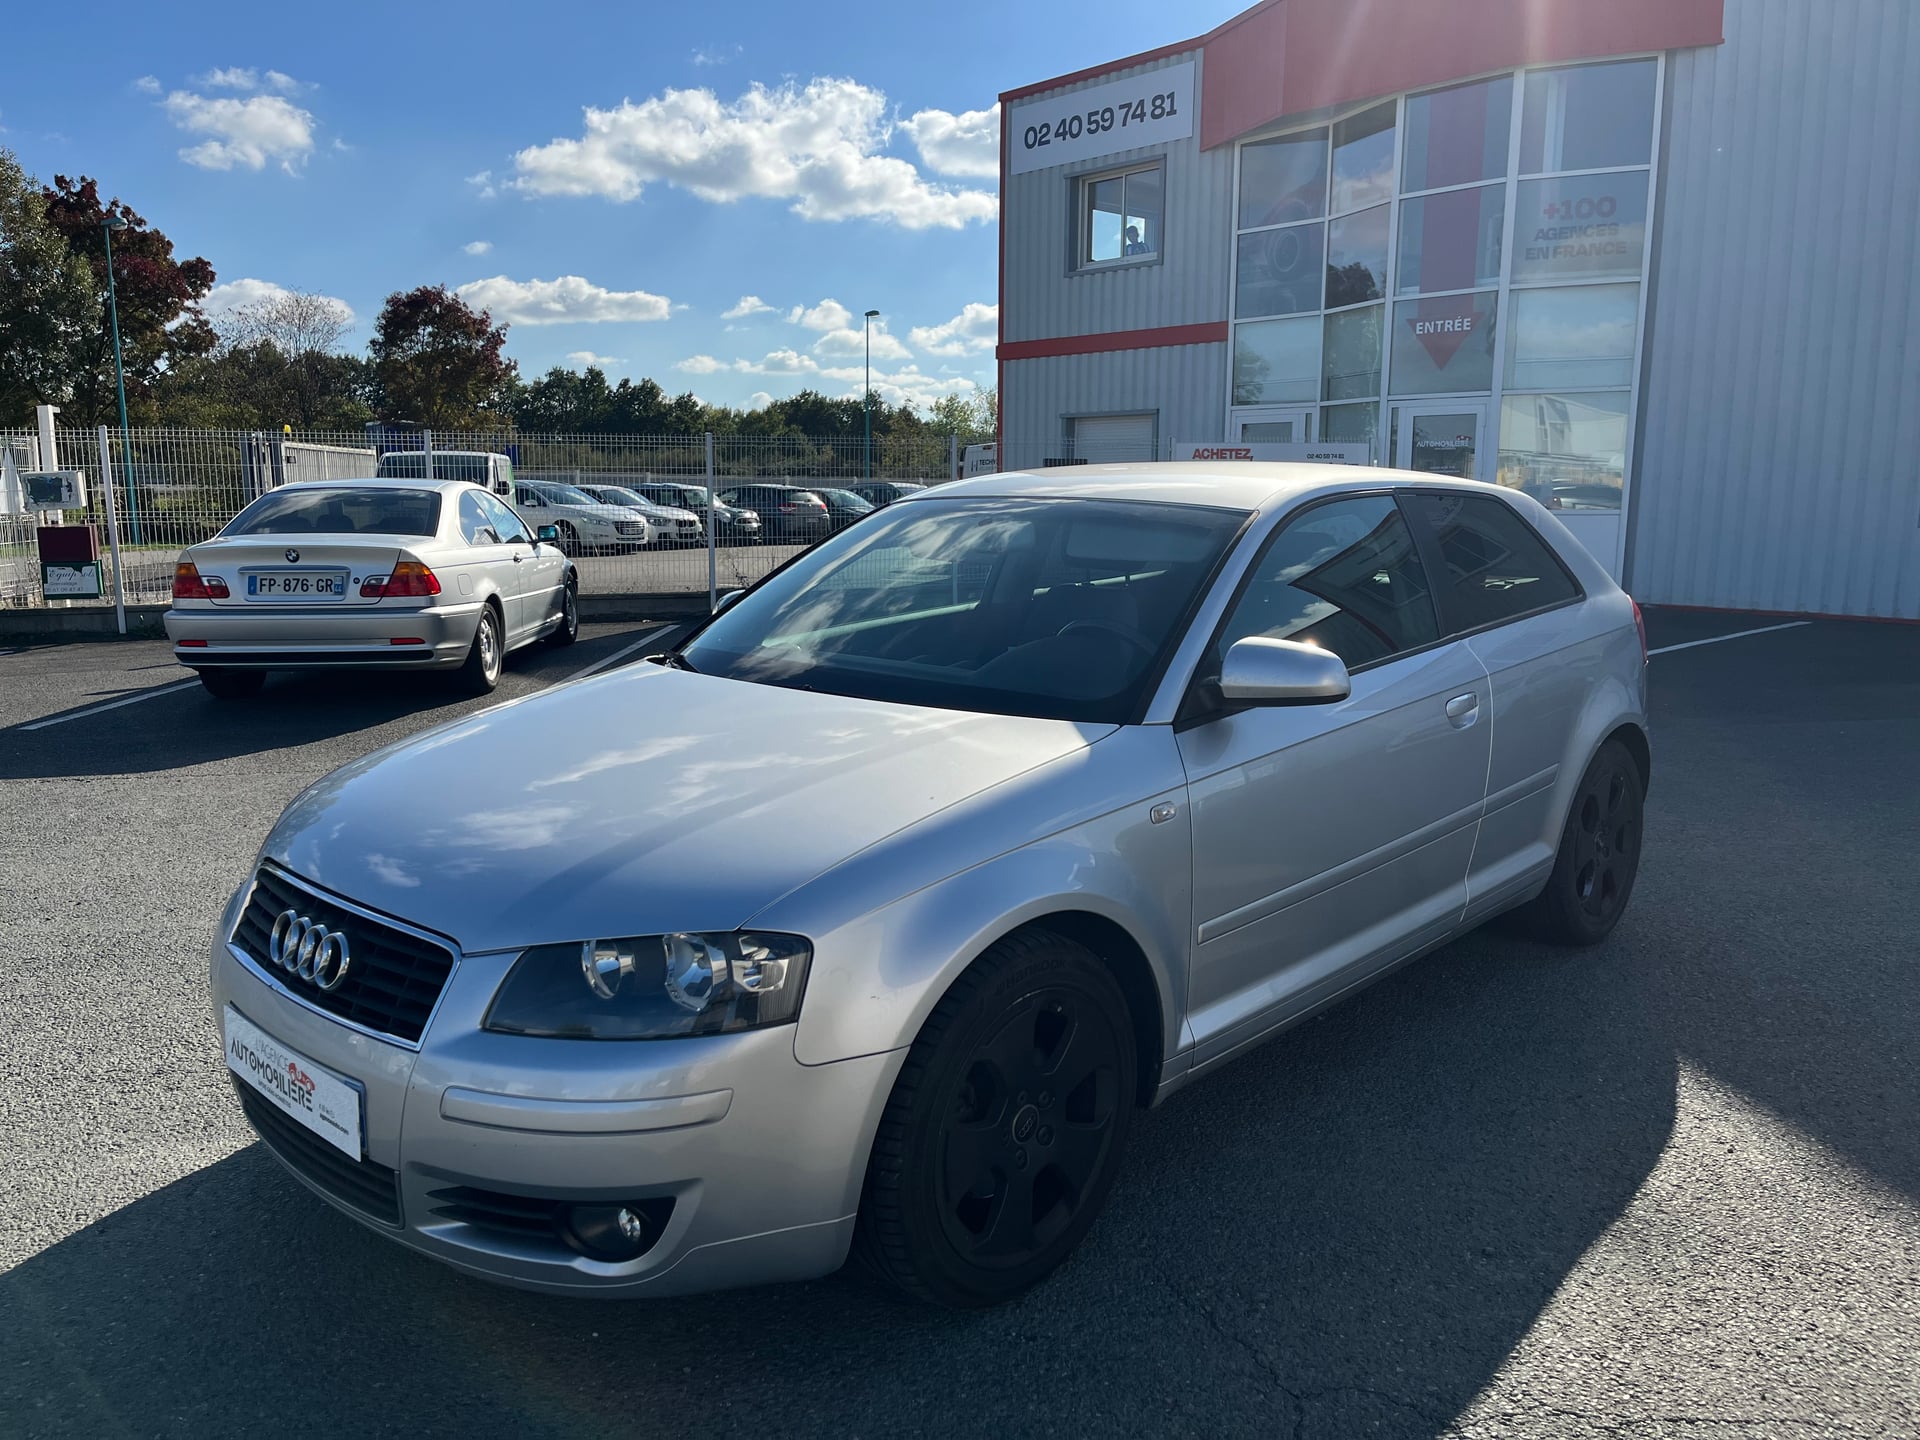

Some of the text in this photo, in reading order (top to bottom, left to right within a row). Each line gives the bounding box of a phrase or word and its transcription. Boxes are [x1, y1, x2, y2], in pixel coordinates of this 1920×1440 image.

[1024, 91, 1177, 149] 02 40 59 74 81
[1543, 195, 1617, 220] +100
[1533, 222, 1620, 242] AGENCES
[1524, 241, 1628, 261] EN FRANCE
[1415, 315, 1472, 335] ENTRÉE
[1192, 448, 1254, 462] ACHETEZ,
[259, 577, 334, 593] FP-876-GR
